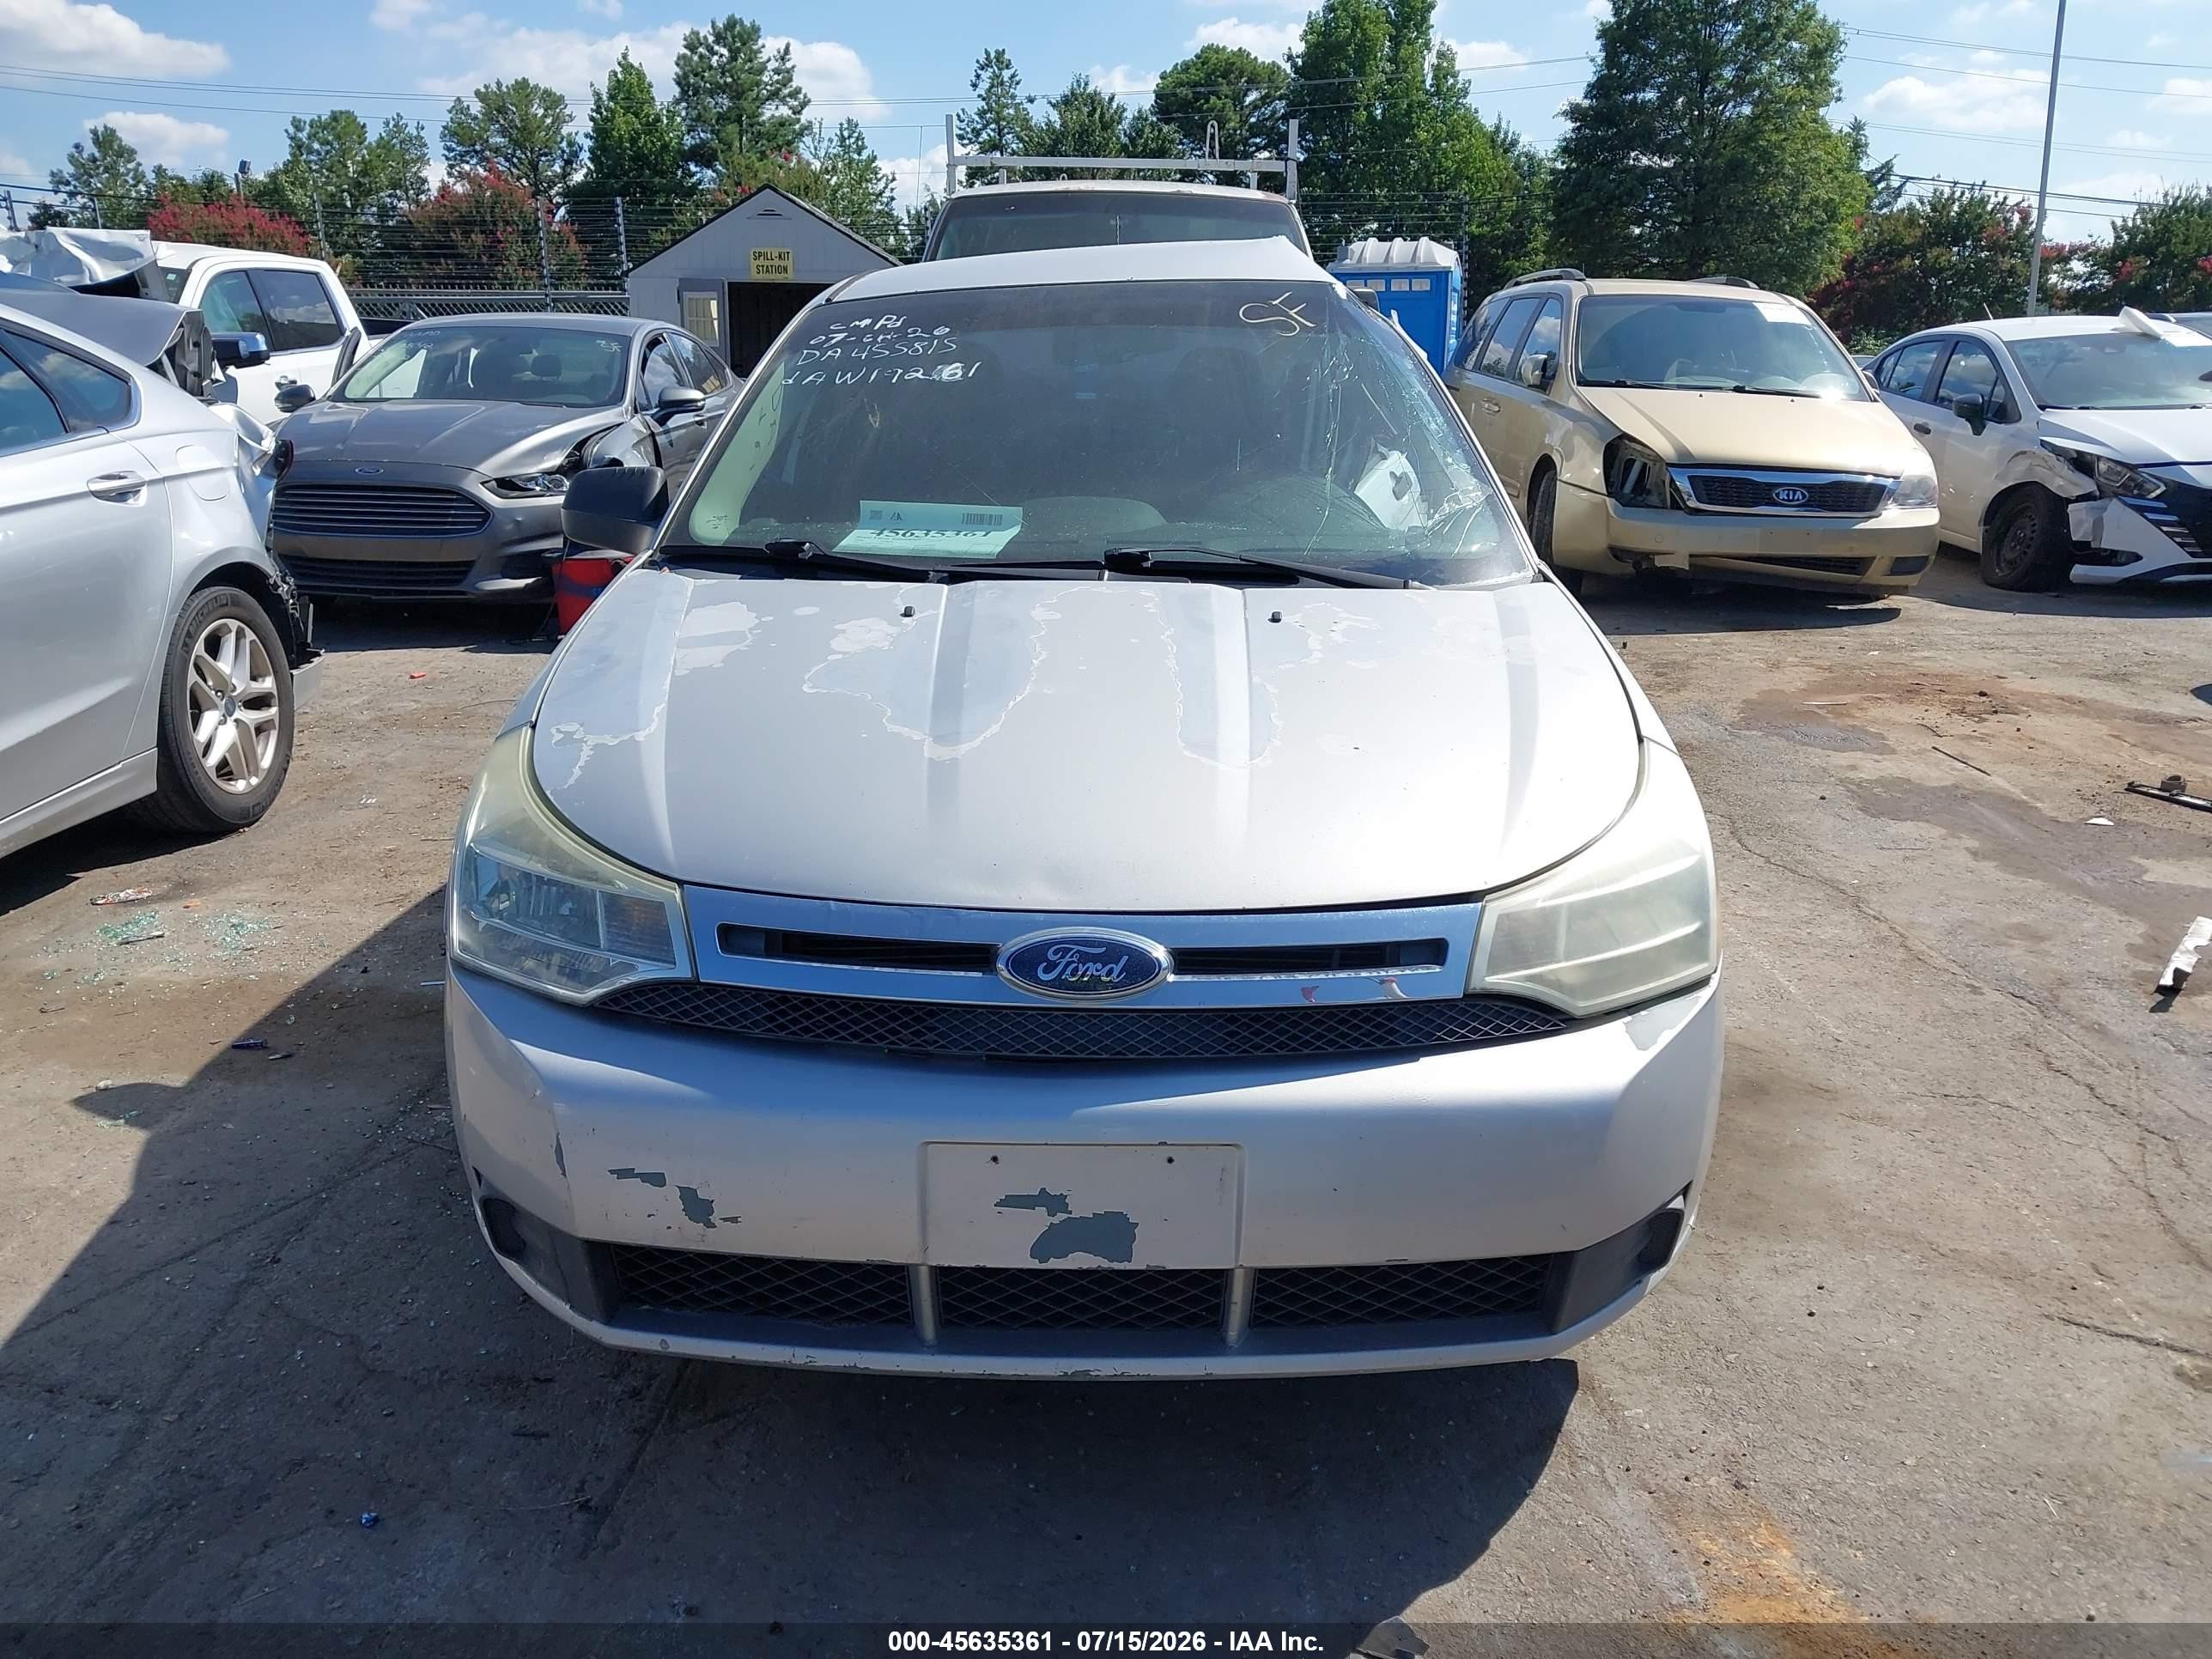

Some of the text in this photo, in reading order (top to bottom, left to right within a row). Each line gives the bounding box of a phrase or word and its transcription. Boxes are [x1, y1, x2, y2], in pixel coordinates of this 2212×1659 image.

[752, 251, 791, 261] SPILL-KIT
[756, 264, 788, 275] STATION
[1778, 490, 1802, 500] KIA
[1037, 945, 1128, 982] Ford
